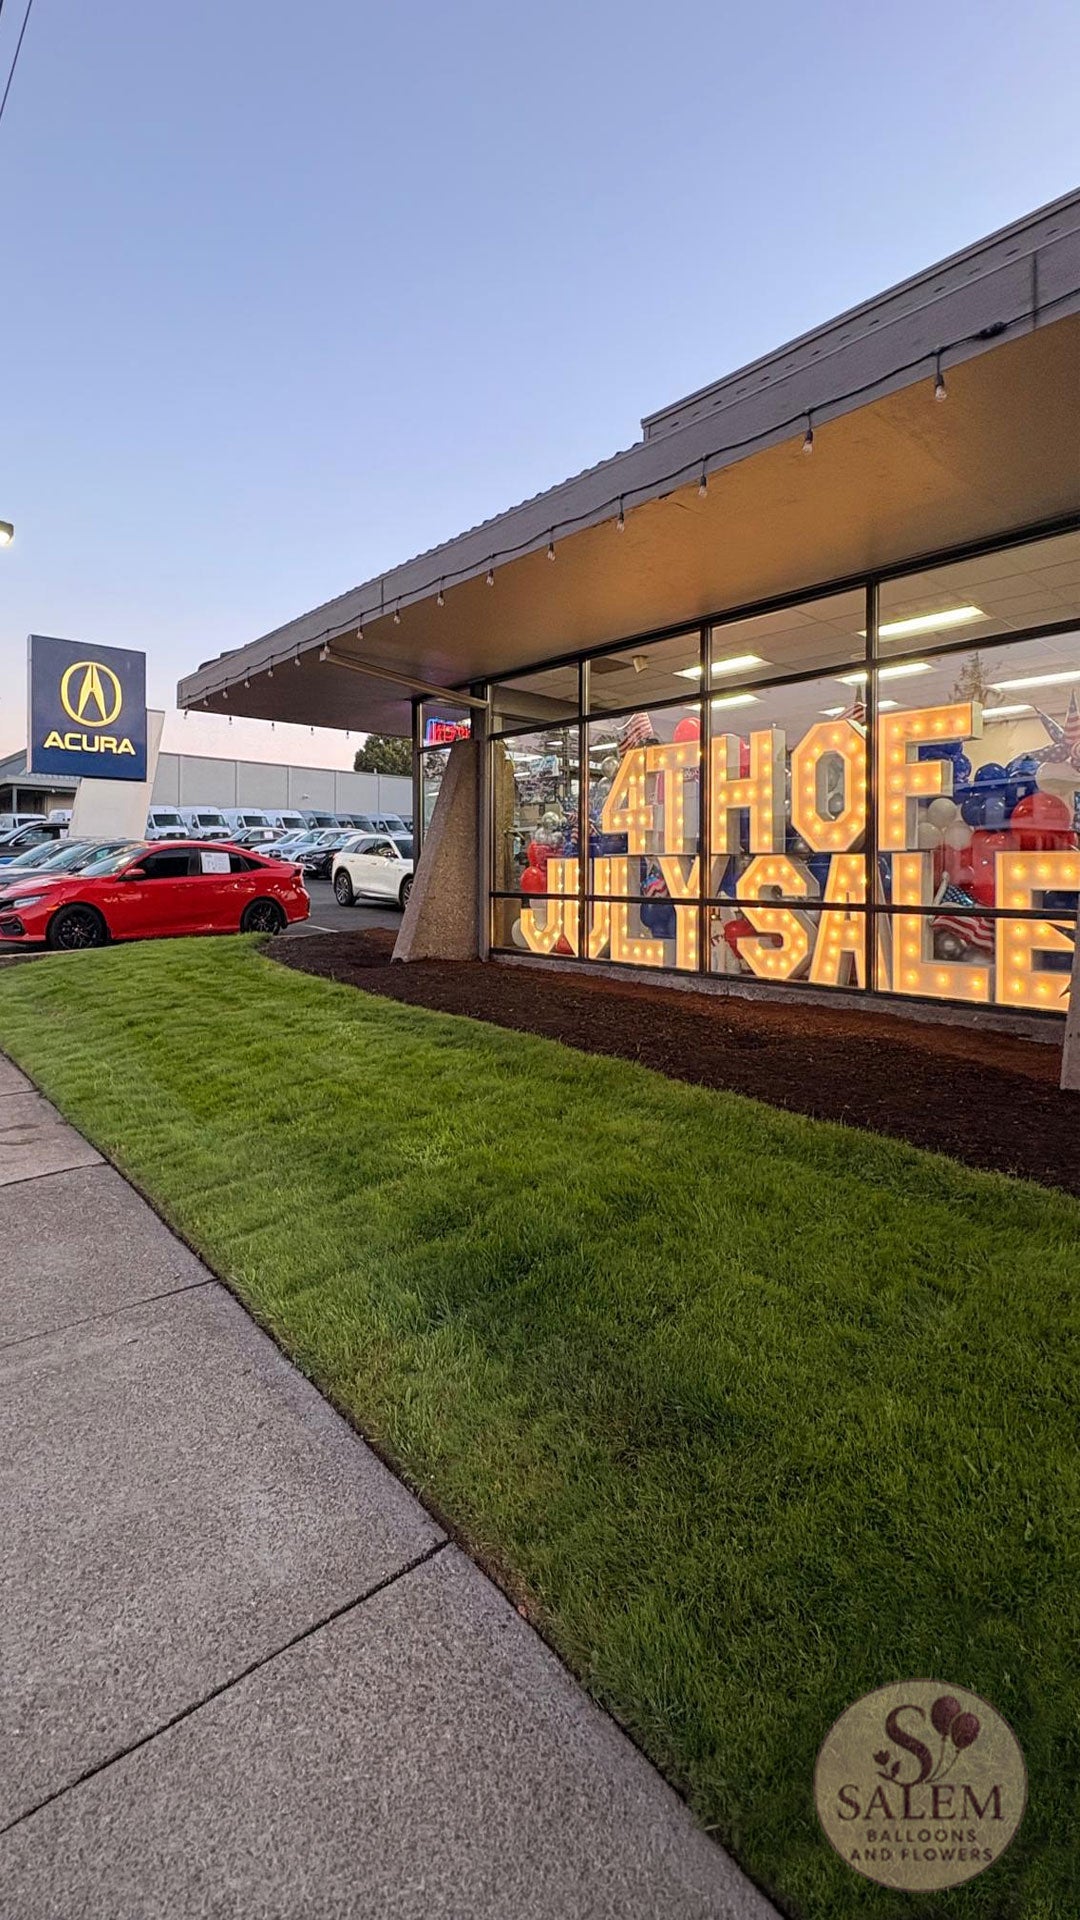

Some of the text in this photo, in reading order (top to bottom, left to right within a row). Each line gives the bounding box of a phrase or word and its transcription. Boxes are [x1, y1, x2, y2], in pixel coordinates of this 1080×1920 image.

[43, 731, 136, 755] ACURA
[791, 701, 980, 853] OF
[521, 852, 1080, 1012] JULY SALE
